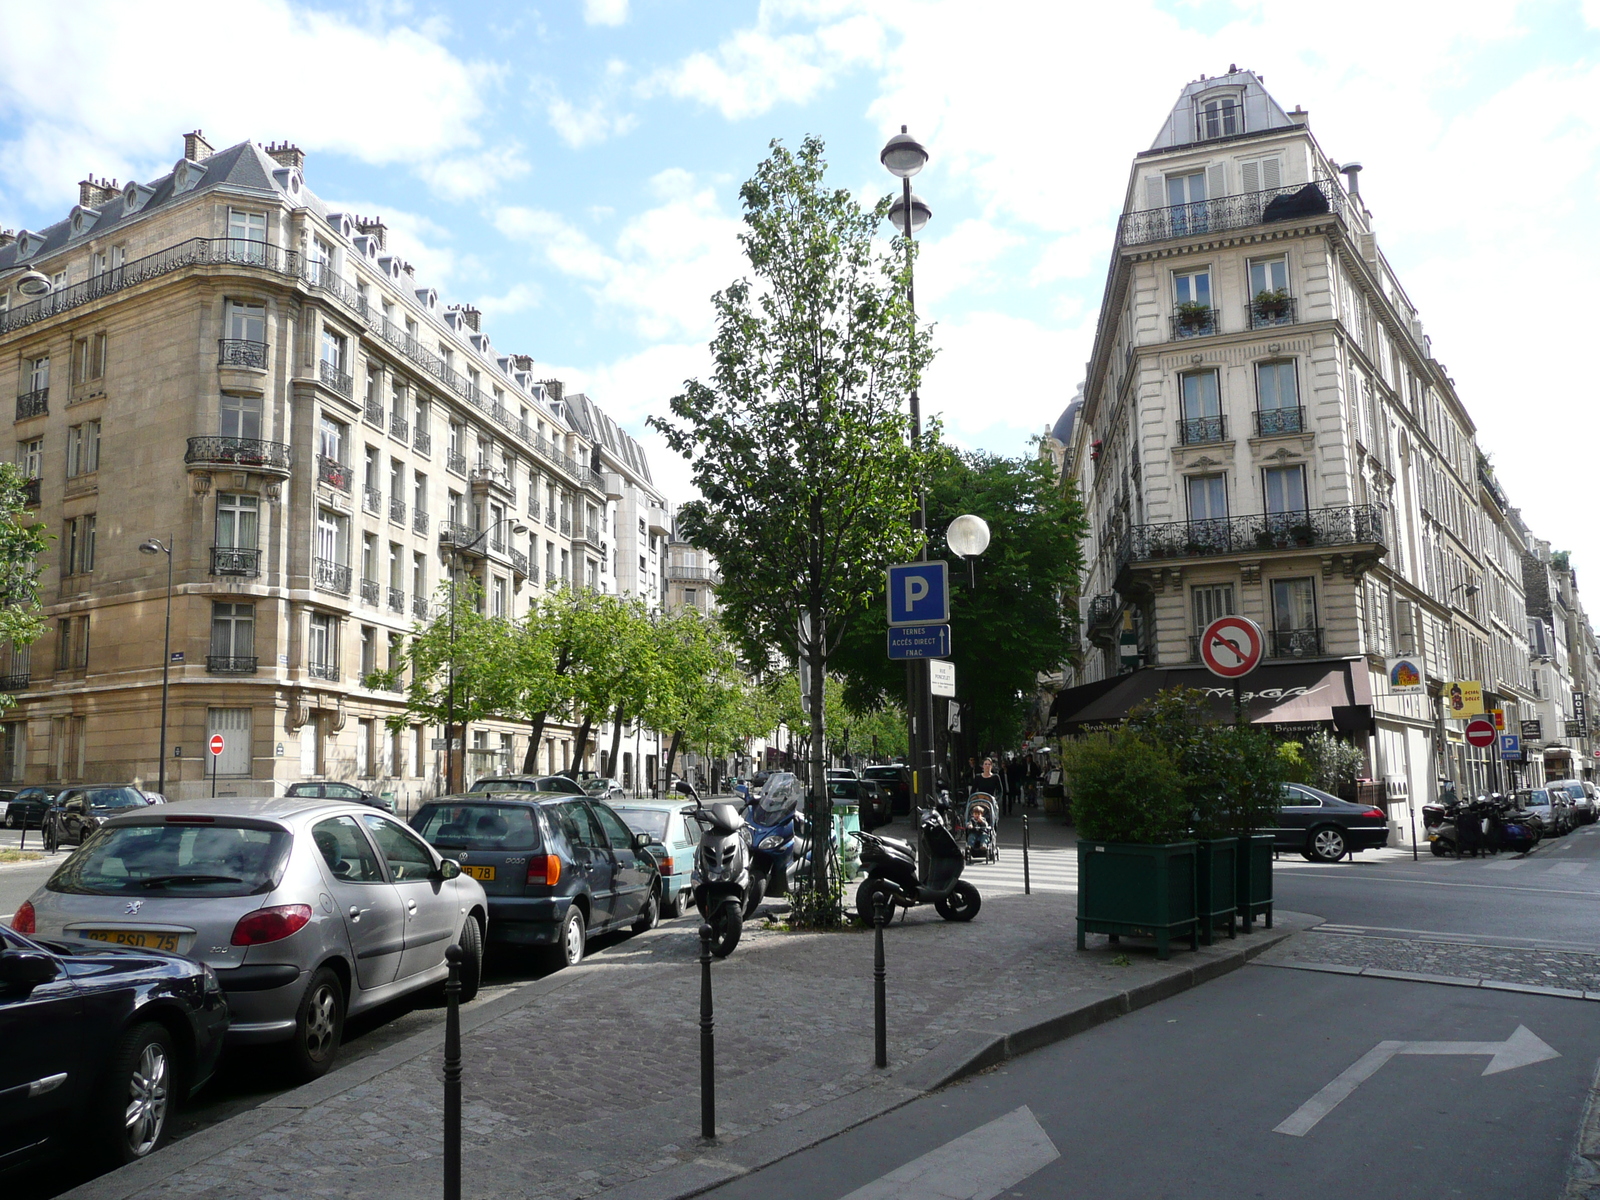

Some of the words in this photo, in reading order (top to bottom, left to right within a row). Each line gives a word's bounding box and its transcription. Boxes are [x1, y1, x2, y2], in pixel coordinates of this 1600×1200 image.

[905, 576, 929, 612] P
[914, 637, 936, 645] DIRECT
[1574, 694, 1584, 727] HOTEL
[1504, 737, 1514, 749] P
[478, 867, 491, 879] 78
[156, 934, 175, 952] 75
